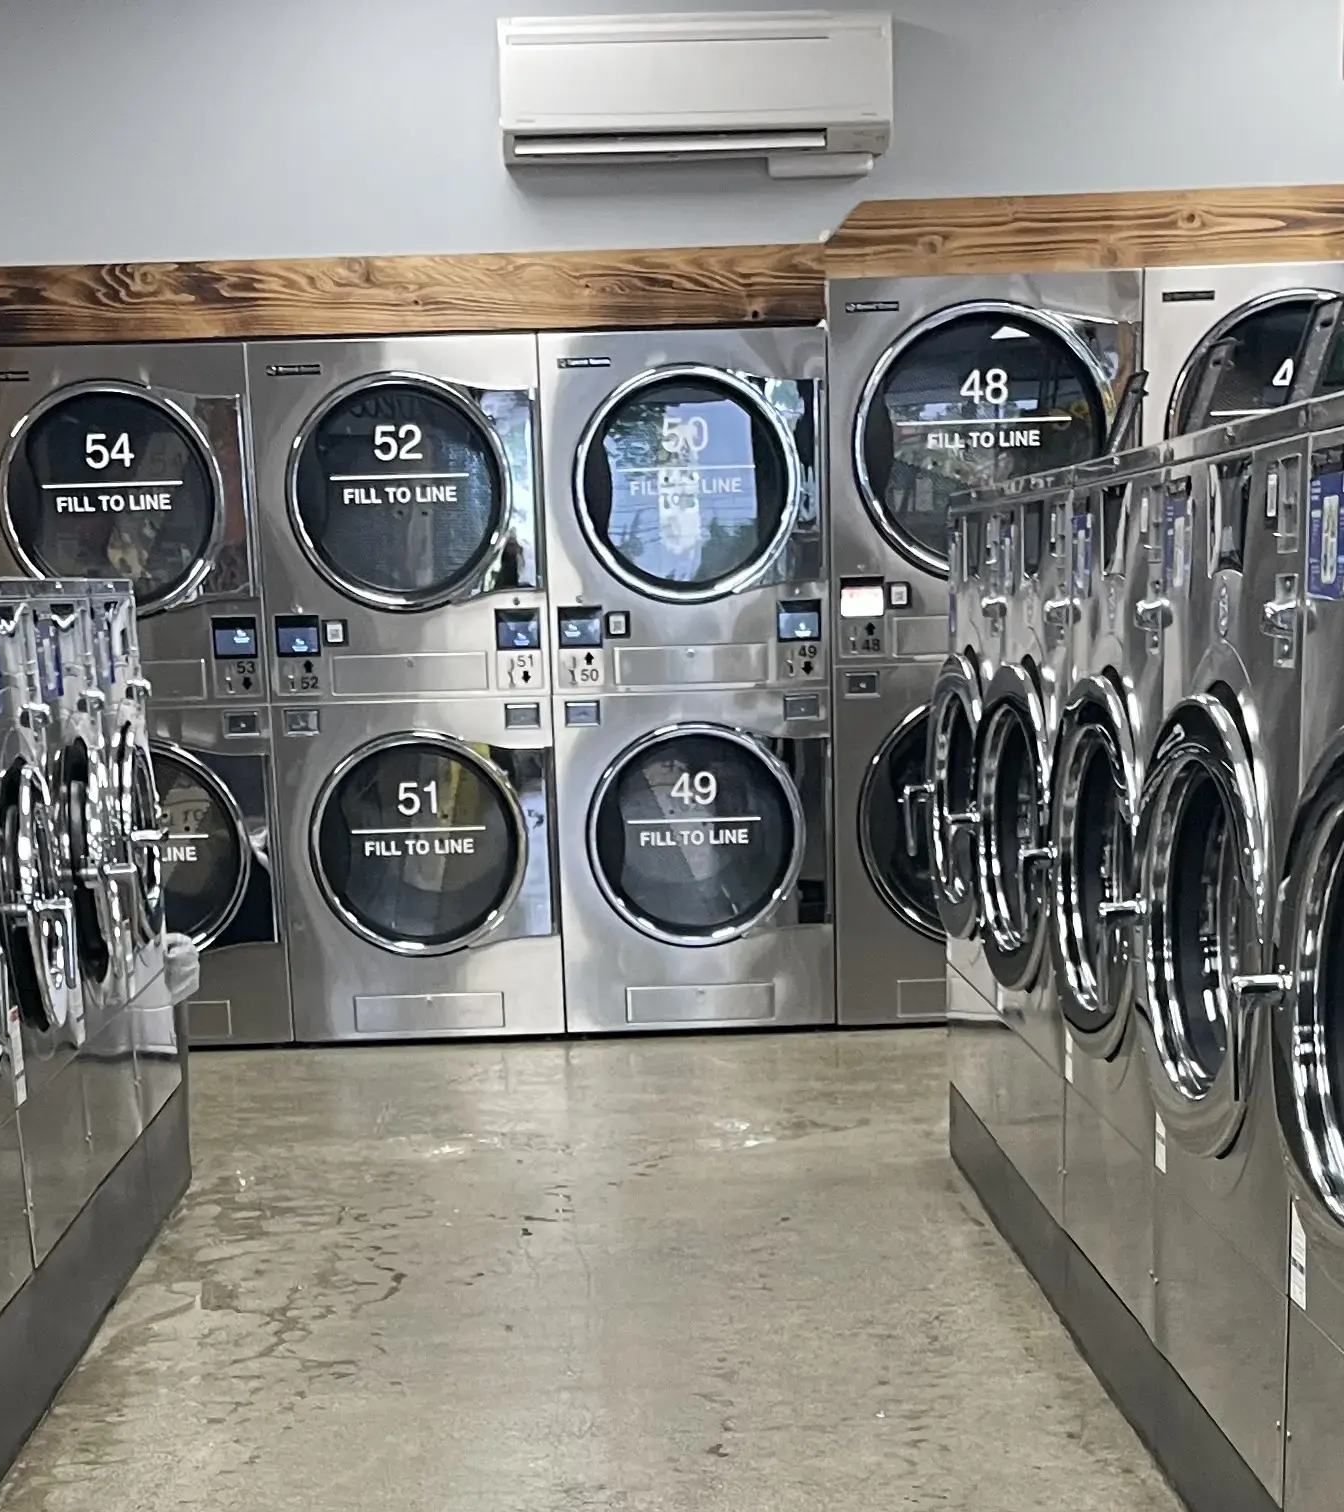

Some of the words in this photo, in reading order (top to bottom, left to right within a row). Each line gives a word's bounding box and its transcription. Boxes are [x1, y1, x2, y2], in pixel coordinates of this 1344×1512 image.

[959, 368, 1009, 405] 48
[373, 424, 424, 462] 52
[926, 430, 965, 449] FILL
[969, 430, 994, 449] TO
[999, 428, 1041, 448] LINE
[85, 432, 135, 470] 54
[343, 487, 382, 506] FILL
[387, 486, 411, 504] TO
[415, 485, 459, 503] LINE
[629, 480, 660, 497] FIL
[702, 477, 744, 494] LINE
[56, 496, 96, 514] FILL
[98, 495, 125, 513] TO
[129, 493, 173, 512] LINE
[798, 645, 817, 658] 49
[861, 639, 881, 652] 48
[236, 661, 255, 674] 53
[516, 654, 534, 667] 51
[300, 676, 319, 690] 52
[580, 668, 600, 682] 50
[397, 780, 440, 816] 51
[670, 771, 717, 806] 49
[364, 838, 402, 857] FILL
[405, 838, 430, 857] TO
[434, 836, 475, 855] LINE
[640, 829, 676, 847] FILL
[679, 828, 706, 847] TO
[710, 826, 749, 846] LINE
